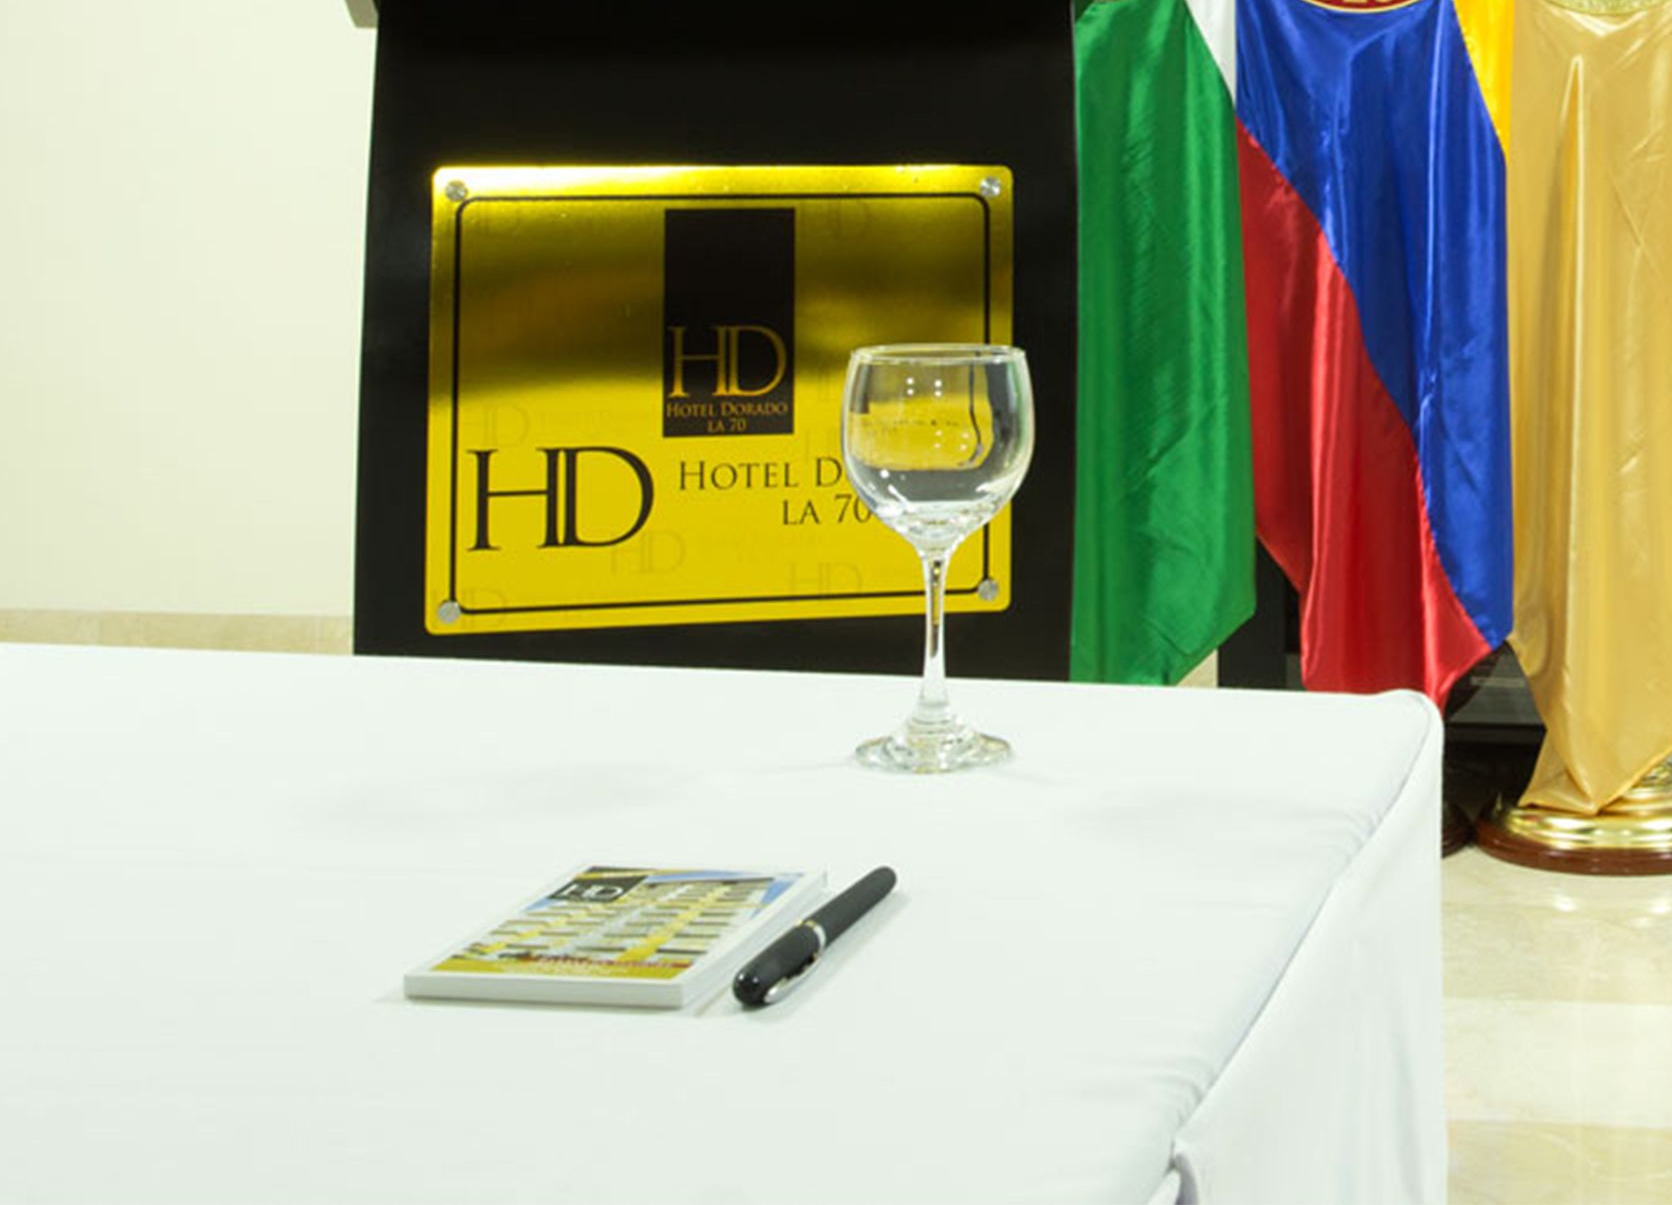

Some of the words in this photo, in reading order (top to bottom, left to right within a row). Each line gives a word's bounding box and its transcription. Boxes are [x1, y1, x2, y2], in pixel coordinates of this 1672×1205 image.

[667, 325, 787, 398] HD
[666, 402, 715, 418] HOTEL
[720, 400, 789, 416] DORADO
[706, 419, 725, 433] LA
[728, 417, 747, 432] 70
[679, 460, 799, 491] HOTEL
[466, 445, 655, 553] HD
[782, 498, 821, 526] LA
